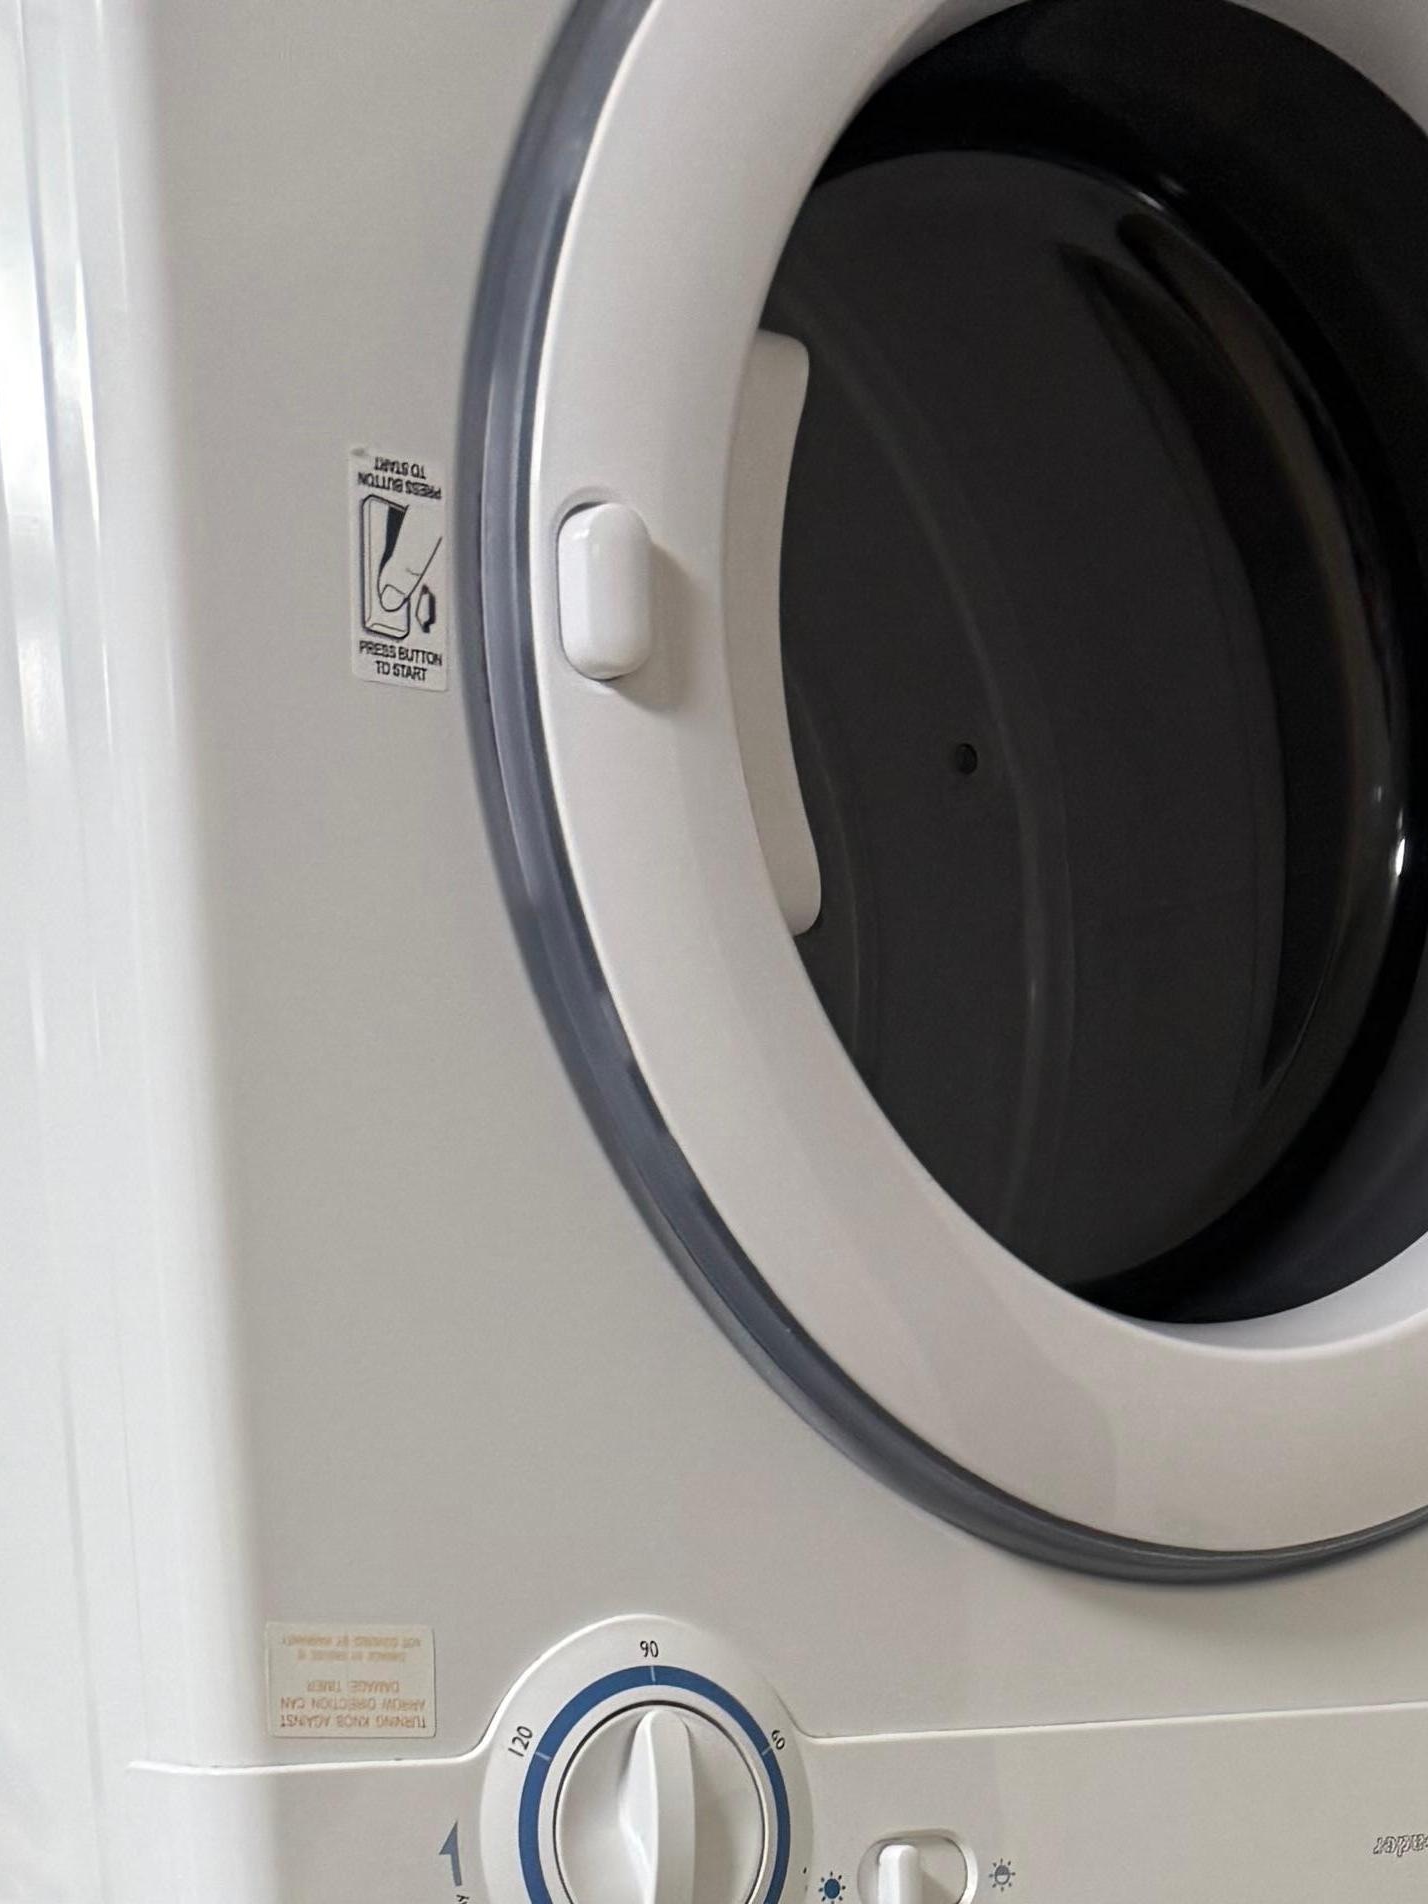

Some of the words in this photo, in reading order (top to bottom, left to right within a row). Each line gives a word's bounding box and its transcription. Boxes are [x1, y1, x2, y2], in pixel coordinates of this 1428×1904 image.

[374, 457, 409, 477] START
[410, 465, 426, 479] TO
[358, 472, 403, 492] BUTTON
[403, 480, 442, 499] PRESS
[359, 641, 396, 658] PRESS
[398, 647, 442, 665] BUTTON
[376, 661, 390, 675] TO
[393, 663, 427, 681] START
[639, 1640, 659, 1658] 90
[307, 1680, 341, 1692] TIMER
[349, 1680, 399, 1692] DAMAGE
[280, 1697, 305, 1709] CAN
[311, 1697, 376, 1710] DIRECTION
[382, 1698, 425, 1710] ARROW
[280, 1714, 330, 1728] AGAINST
[336, 1715, 369, 1728] KNOB
[376, 1715, 426, 1729] TURNING
[508, 1725, 534, 1758] 120
[771, 1729, 786, 1751] 60
